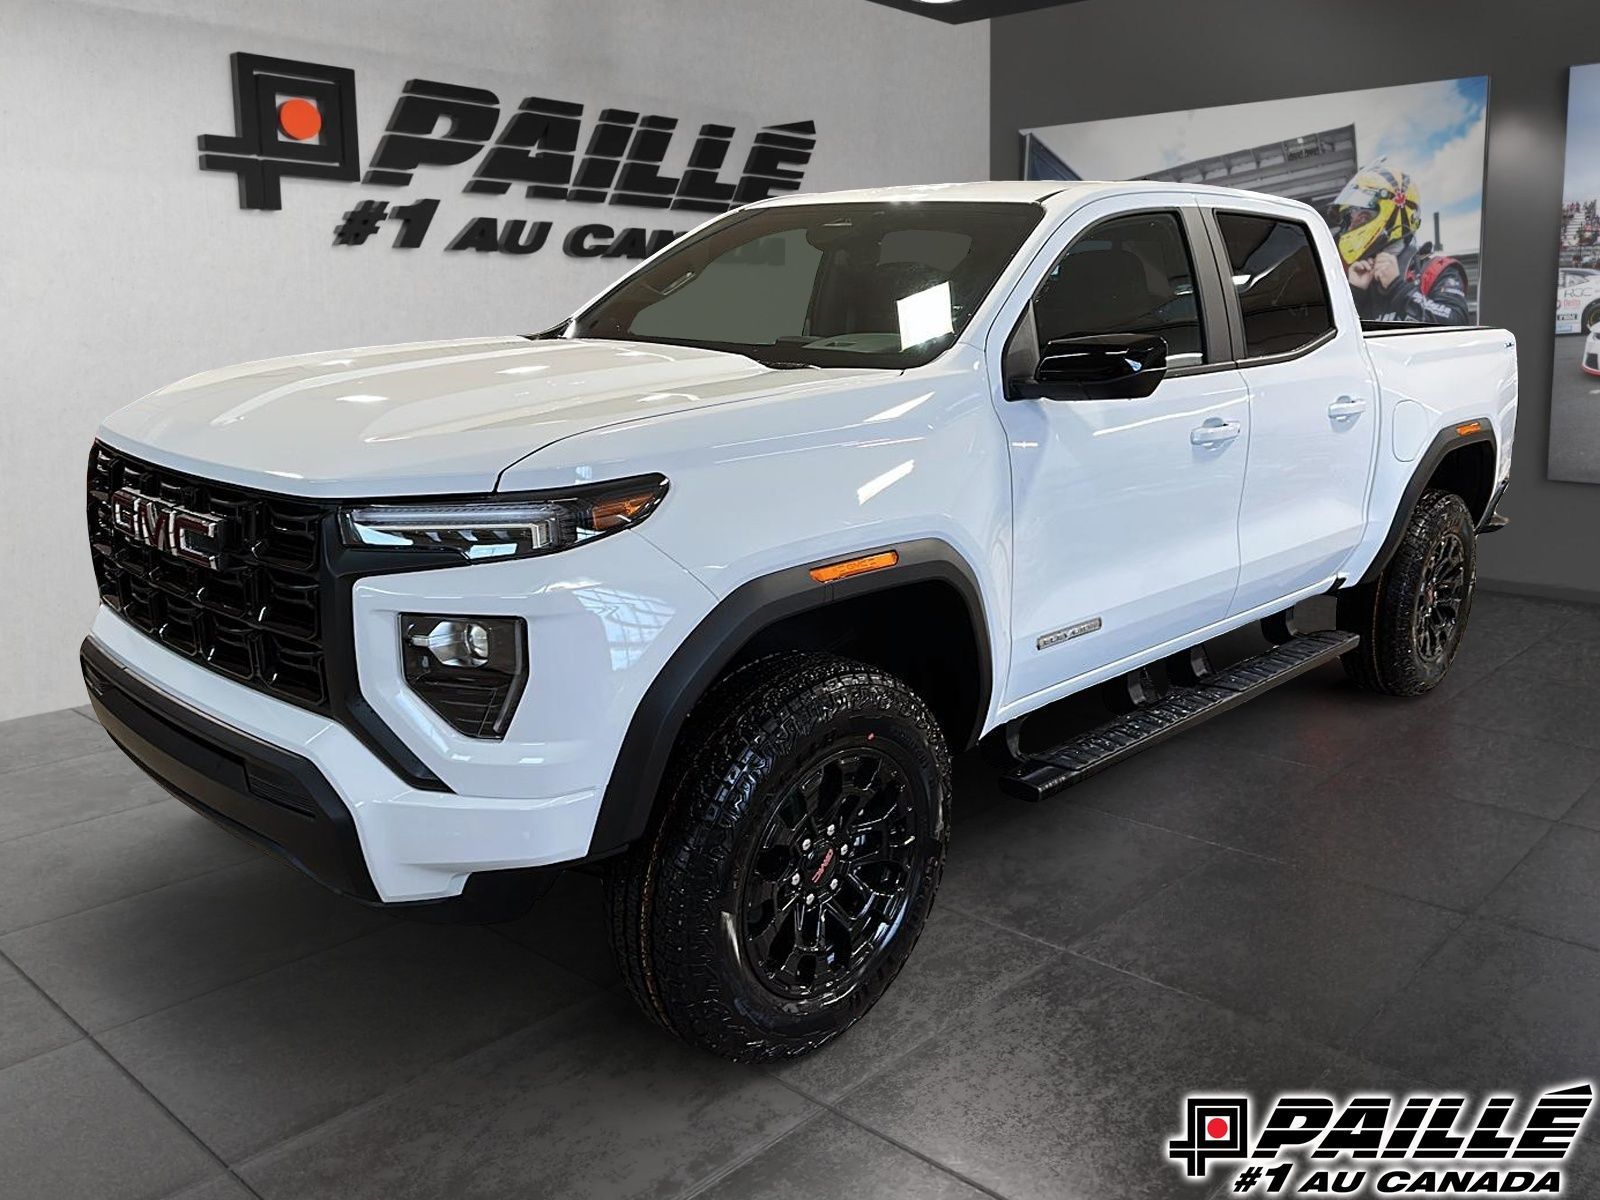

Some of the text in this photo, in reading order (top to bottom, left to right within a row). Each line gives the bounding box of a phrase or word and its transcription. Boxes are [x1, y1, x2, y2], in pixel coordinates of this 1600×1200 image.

[361, 79, 816, 213] PAILLÉ
[332, 199, 441, 248] #1
[444, 217, 553, 254] AU
[111, 487, 222, 570] GMC
[811, 848, 834, 883] GMC
